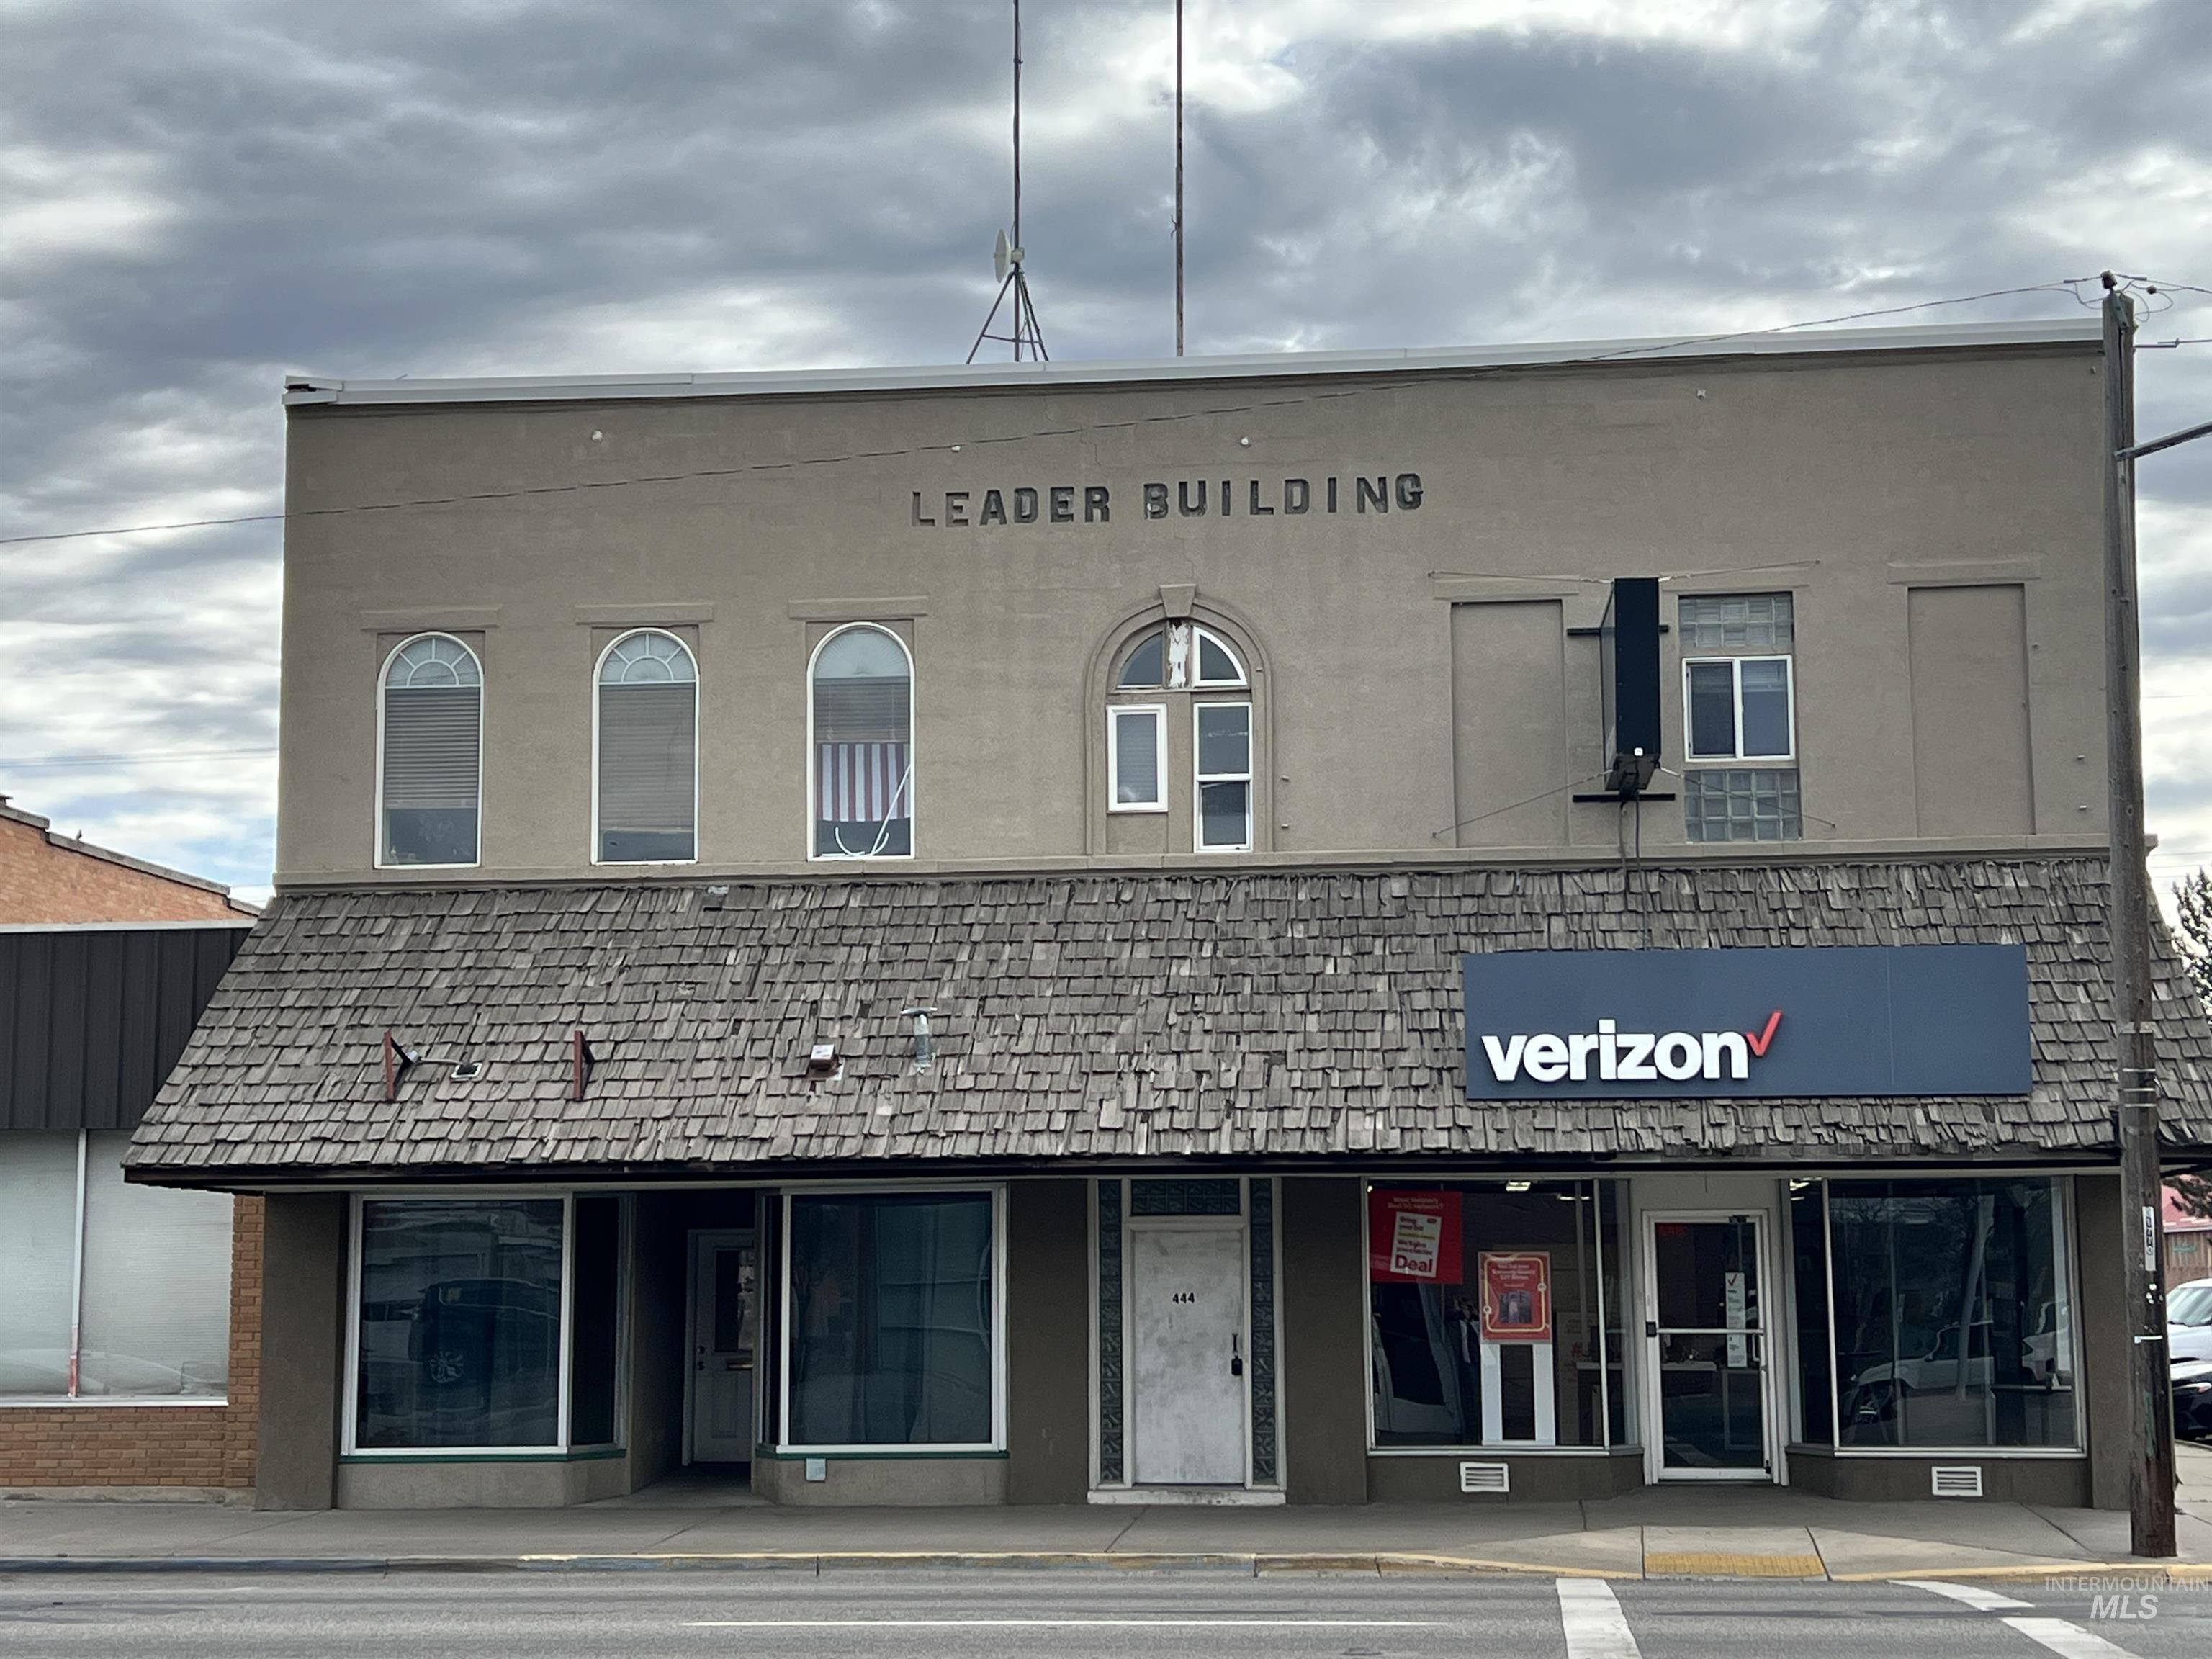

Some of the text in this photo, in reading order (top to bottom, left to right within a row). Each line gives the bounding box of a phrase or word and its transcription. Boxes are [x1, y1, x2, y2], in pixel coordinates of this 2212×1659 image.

[912, 473, 1424, 527] LEADER BUILDING
[1481, 1019, 1749, 1082] verizon
[1395, 1254, 1433, 1272] Deal
[1172, 1292, 1195, 1304] 444
